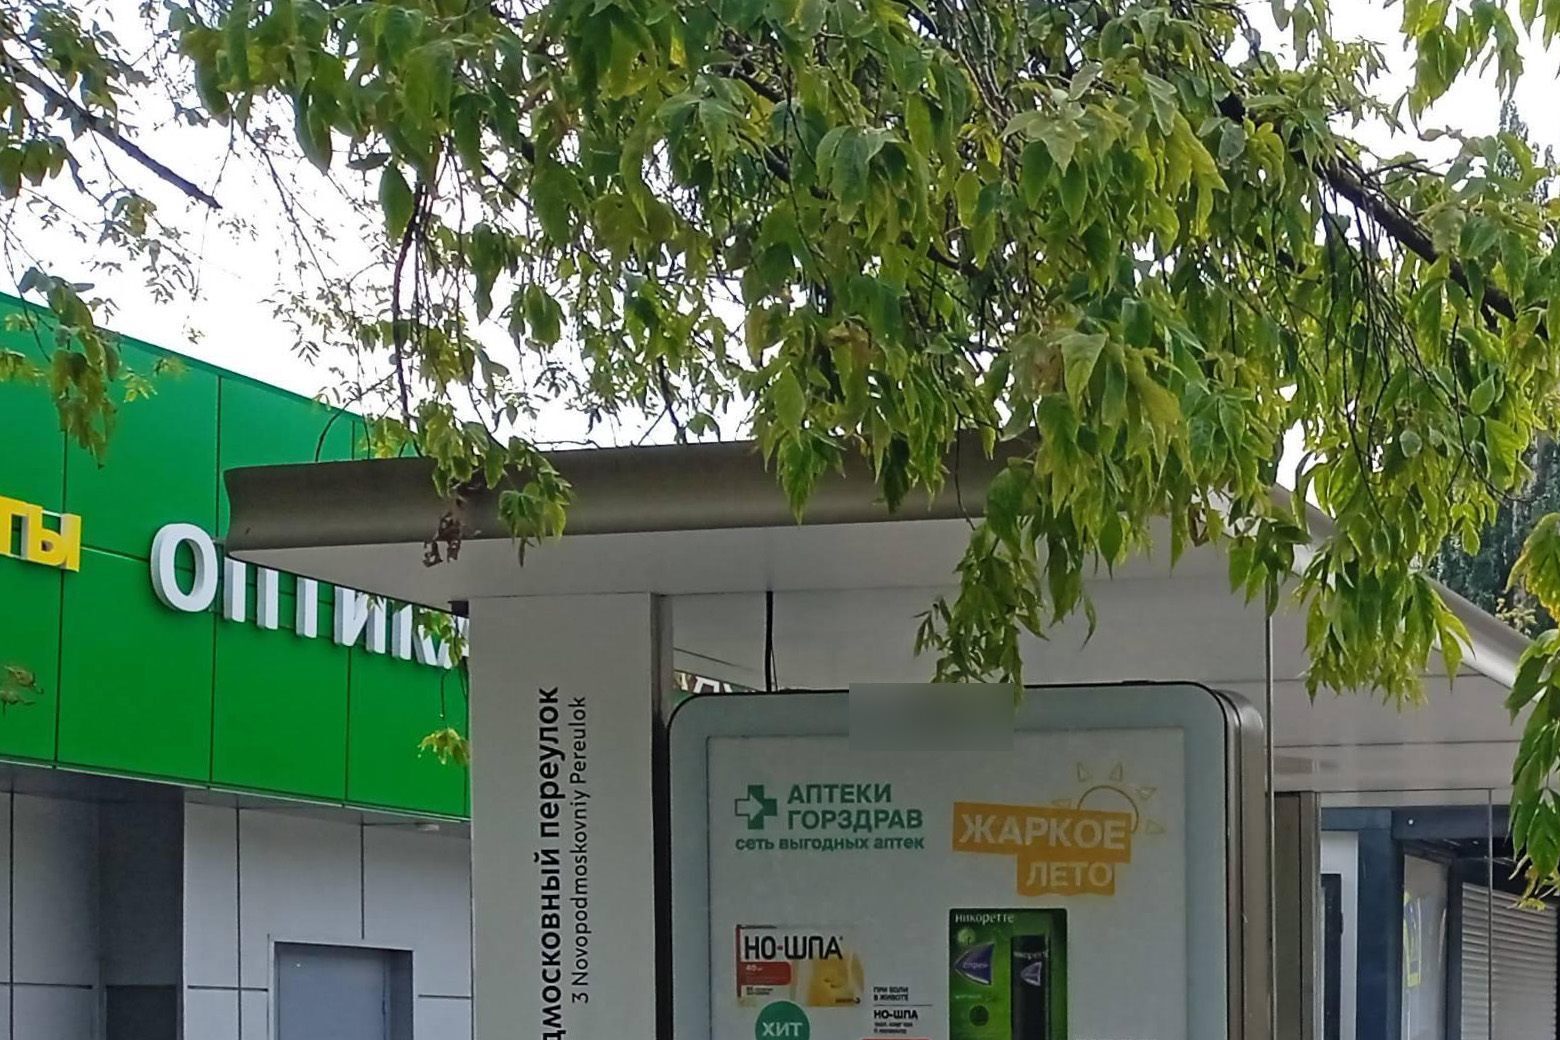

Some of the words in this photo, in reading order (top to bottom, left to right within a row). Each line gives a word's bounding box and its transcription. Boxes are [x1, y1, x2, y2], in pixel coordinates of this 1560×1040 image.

[568, 696, 588, 784] Pereulok
[538, 686, 566, 839] переулок
[787, 784, 892, 804] АПТЕКИ
[787, 809, 923, 833] ГОРЗДРАВ
[958, 812, 1127, 851] ЖАРКОЕ
[735, 838, 775, 850] сеть
[779, 838, 869, 852] выгодных
[874, 837, 925, 850] аптек
[1026, 860, 1114, 888] ЛЕТО
[570, 788, 593, 987] Novopodmoskovniy
[744, 935, 843, 960] НО-ШПА
[572, 992, 588, 1004] 3
[874, 1009, 918, 1020] НО-ШПА
[761, 1021, 802, 1038] ХИТ
